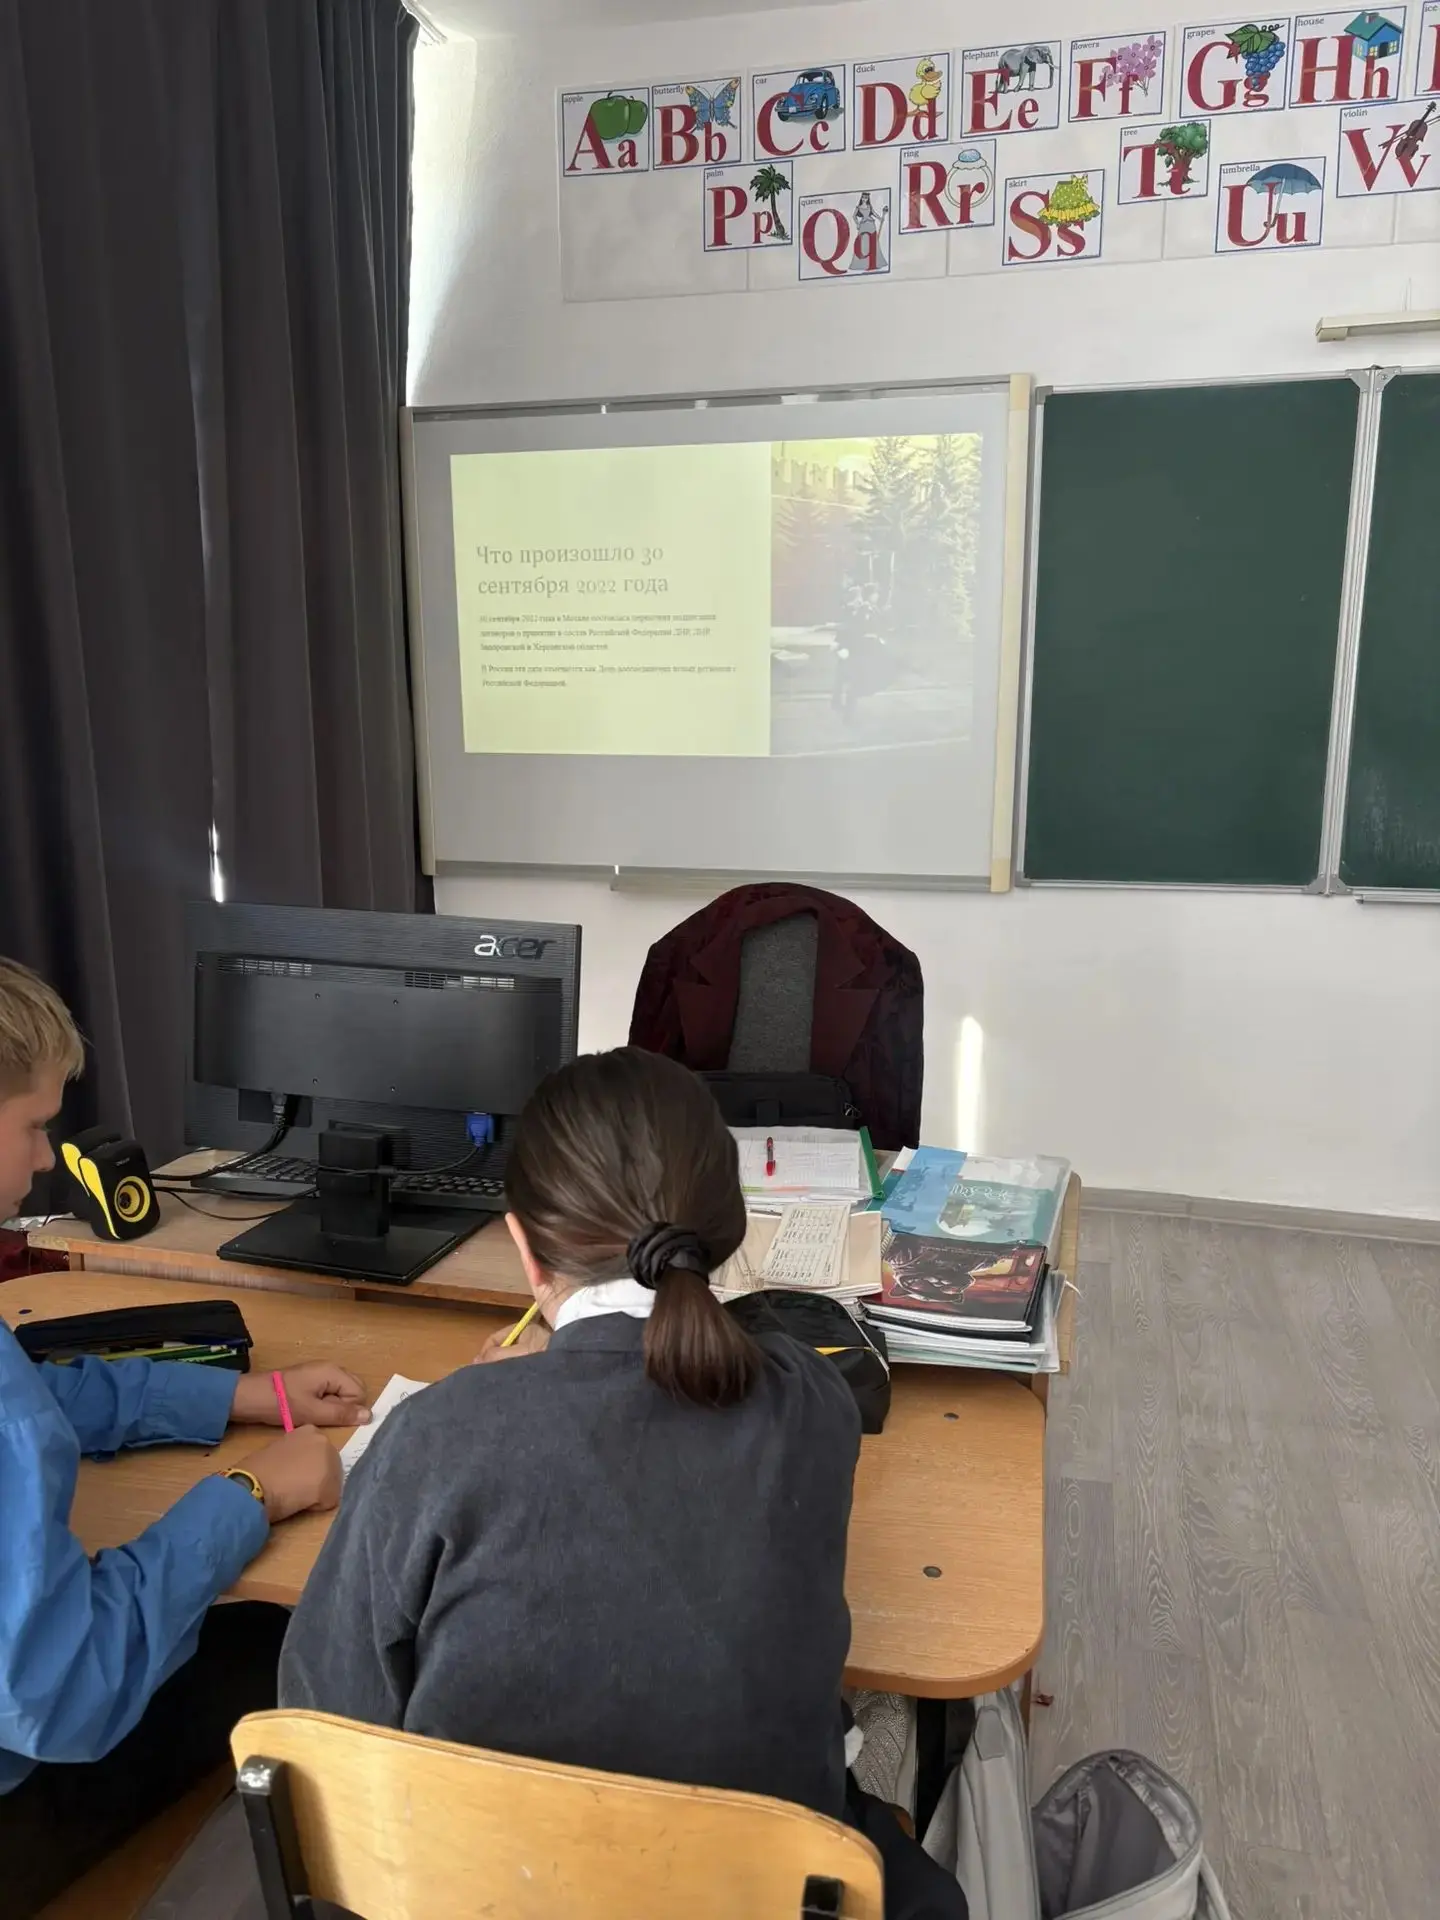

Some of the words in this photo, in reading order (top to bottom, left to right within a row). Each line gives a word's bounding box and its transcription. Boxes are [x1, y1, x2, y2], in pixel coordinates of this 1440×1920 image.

[1297, 17, 1325, 27] house
[1187, 27, 1216, 39] grapes
[1072, 40, 1100, 51] flowers
[964, 49, 999, 61] elephant
[856, 64, 876, 73] duck
[1294, 35, 1390, 104] Hh
[755, 77, 768, 85] car
[654, 84, 685, 95] butterfly
[965, 69, 1039, 134] Ee
[857, 82, 941, 146] Dd
[1343, 107, 1368, 118] violin
[756, 92, 829, 156] Cc
[1123, 128, 1138, 137] tree
[903, 149, 920, 159] ring
[706, 168, 724, 179] palm
[1222, 163, 1261, 175] umbrella
[1008, 179, 1028, 189] skirt
[903, 162, 985, 229] Rr
[801, 197, 824, 207] queen
[1223, 183, 1307, 247] Uu
[803, 208, 880, 275] Qq
[476, 545, 513, 565] Что
[520, 547, 635, 568] произошло
[640, 547, 664, 566] 30
[477, 575, 570, 598] сентября
[576, 579, 617, 594] 2022
[623, 577, 669, 595] года
[474, 934, 557, 960] acer
